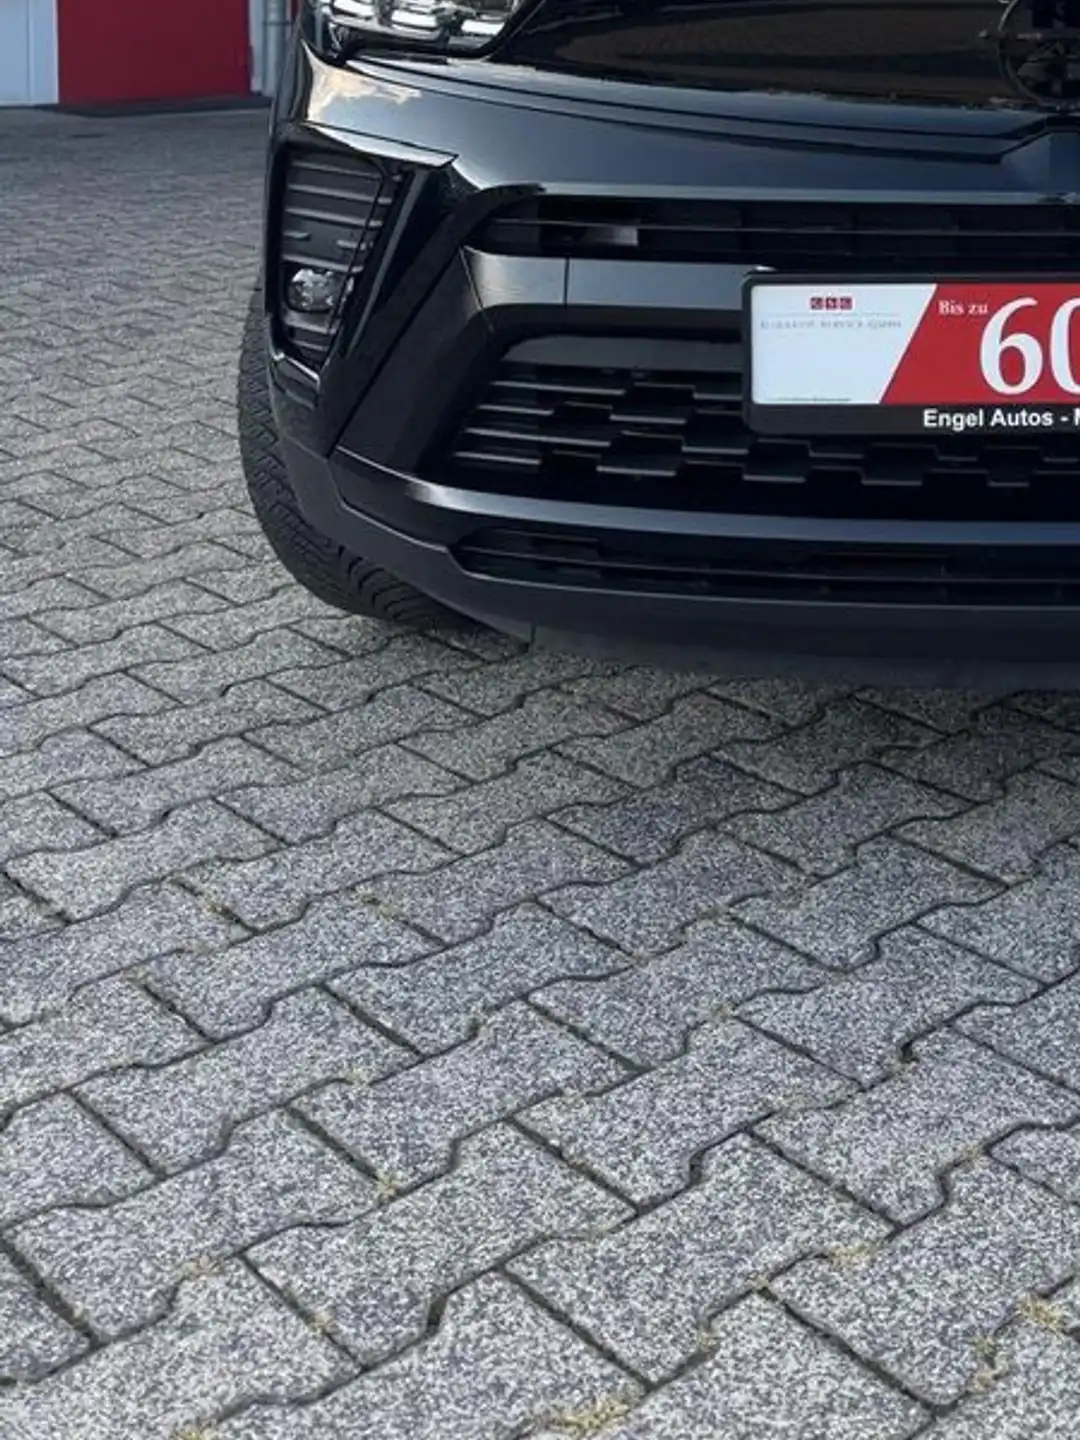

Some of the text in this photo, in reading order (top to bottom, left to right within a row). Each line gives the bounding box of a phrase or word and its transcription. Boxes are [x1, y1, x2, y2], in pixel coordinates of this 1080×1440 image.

[938, 300, 988, 315] Bis zu
[923, 408, 983, 432] Engel
[990, 408, 1053, 427] Autos
